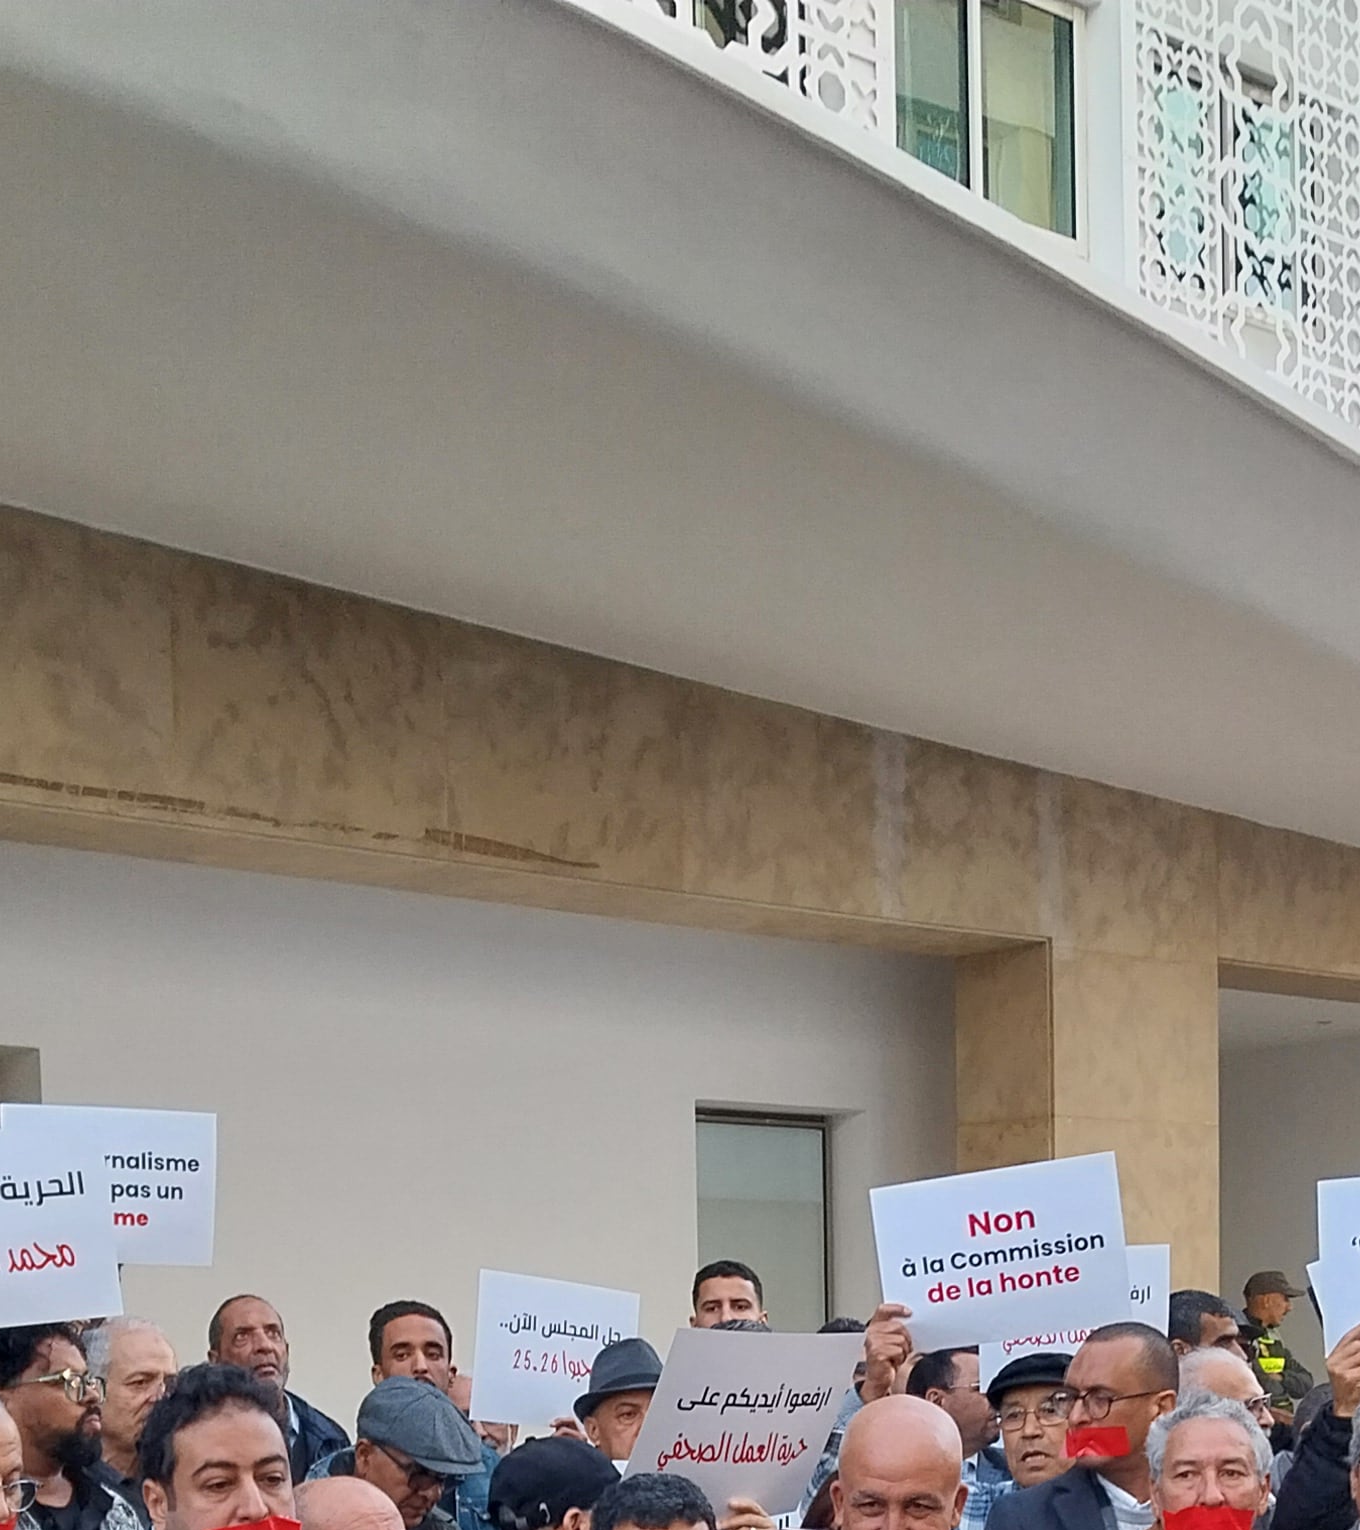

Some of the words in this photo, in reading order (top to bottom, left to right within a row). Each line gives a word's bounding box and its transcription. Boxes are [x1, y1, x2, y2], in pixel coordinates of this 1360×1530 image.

[0, 1171, 85, 1206] الحرية
[111, 1183, 151, 1203] pas
[157, 1185, 183, 1201] un
[968, 1208, 1036, 1238] Non
[7, 1241, 77, 1274] محمد
[902, 1258, 917, 1277] à
[923, 1256, 945, 1274] la
[951, 1232, 1105, 1270] Commission
[927, 1282, 962, 1303] de
[968, 1277, 992, 1297] la
[999, 1264, 1080, 1293] honte
[541, 1319, 599, 1342] المجلس
[512, 1348, 559, 1375] 25.26
[562, 1349, 592, 1383] حبوا
[677, 1385, 721, 1412] على
[720, 1383, 785, 1416] أيديكم
[783, 1386, 833, 1414] ارفعوا
[656, 1430, 733, 1472] الصحفي
[731, 1431, 779, 1465] العمل
[777, 1434, 809, 1466] حرية
